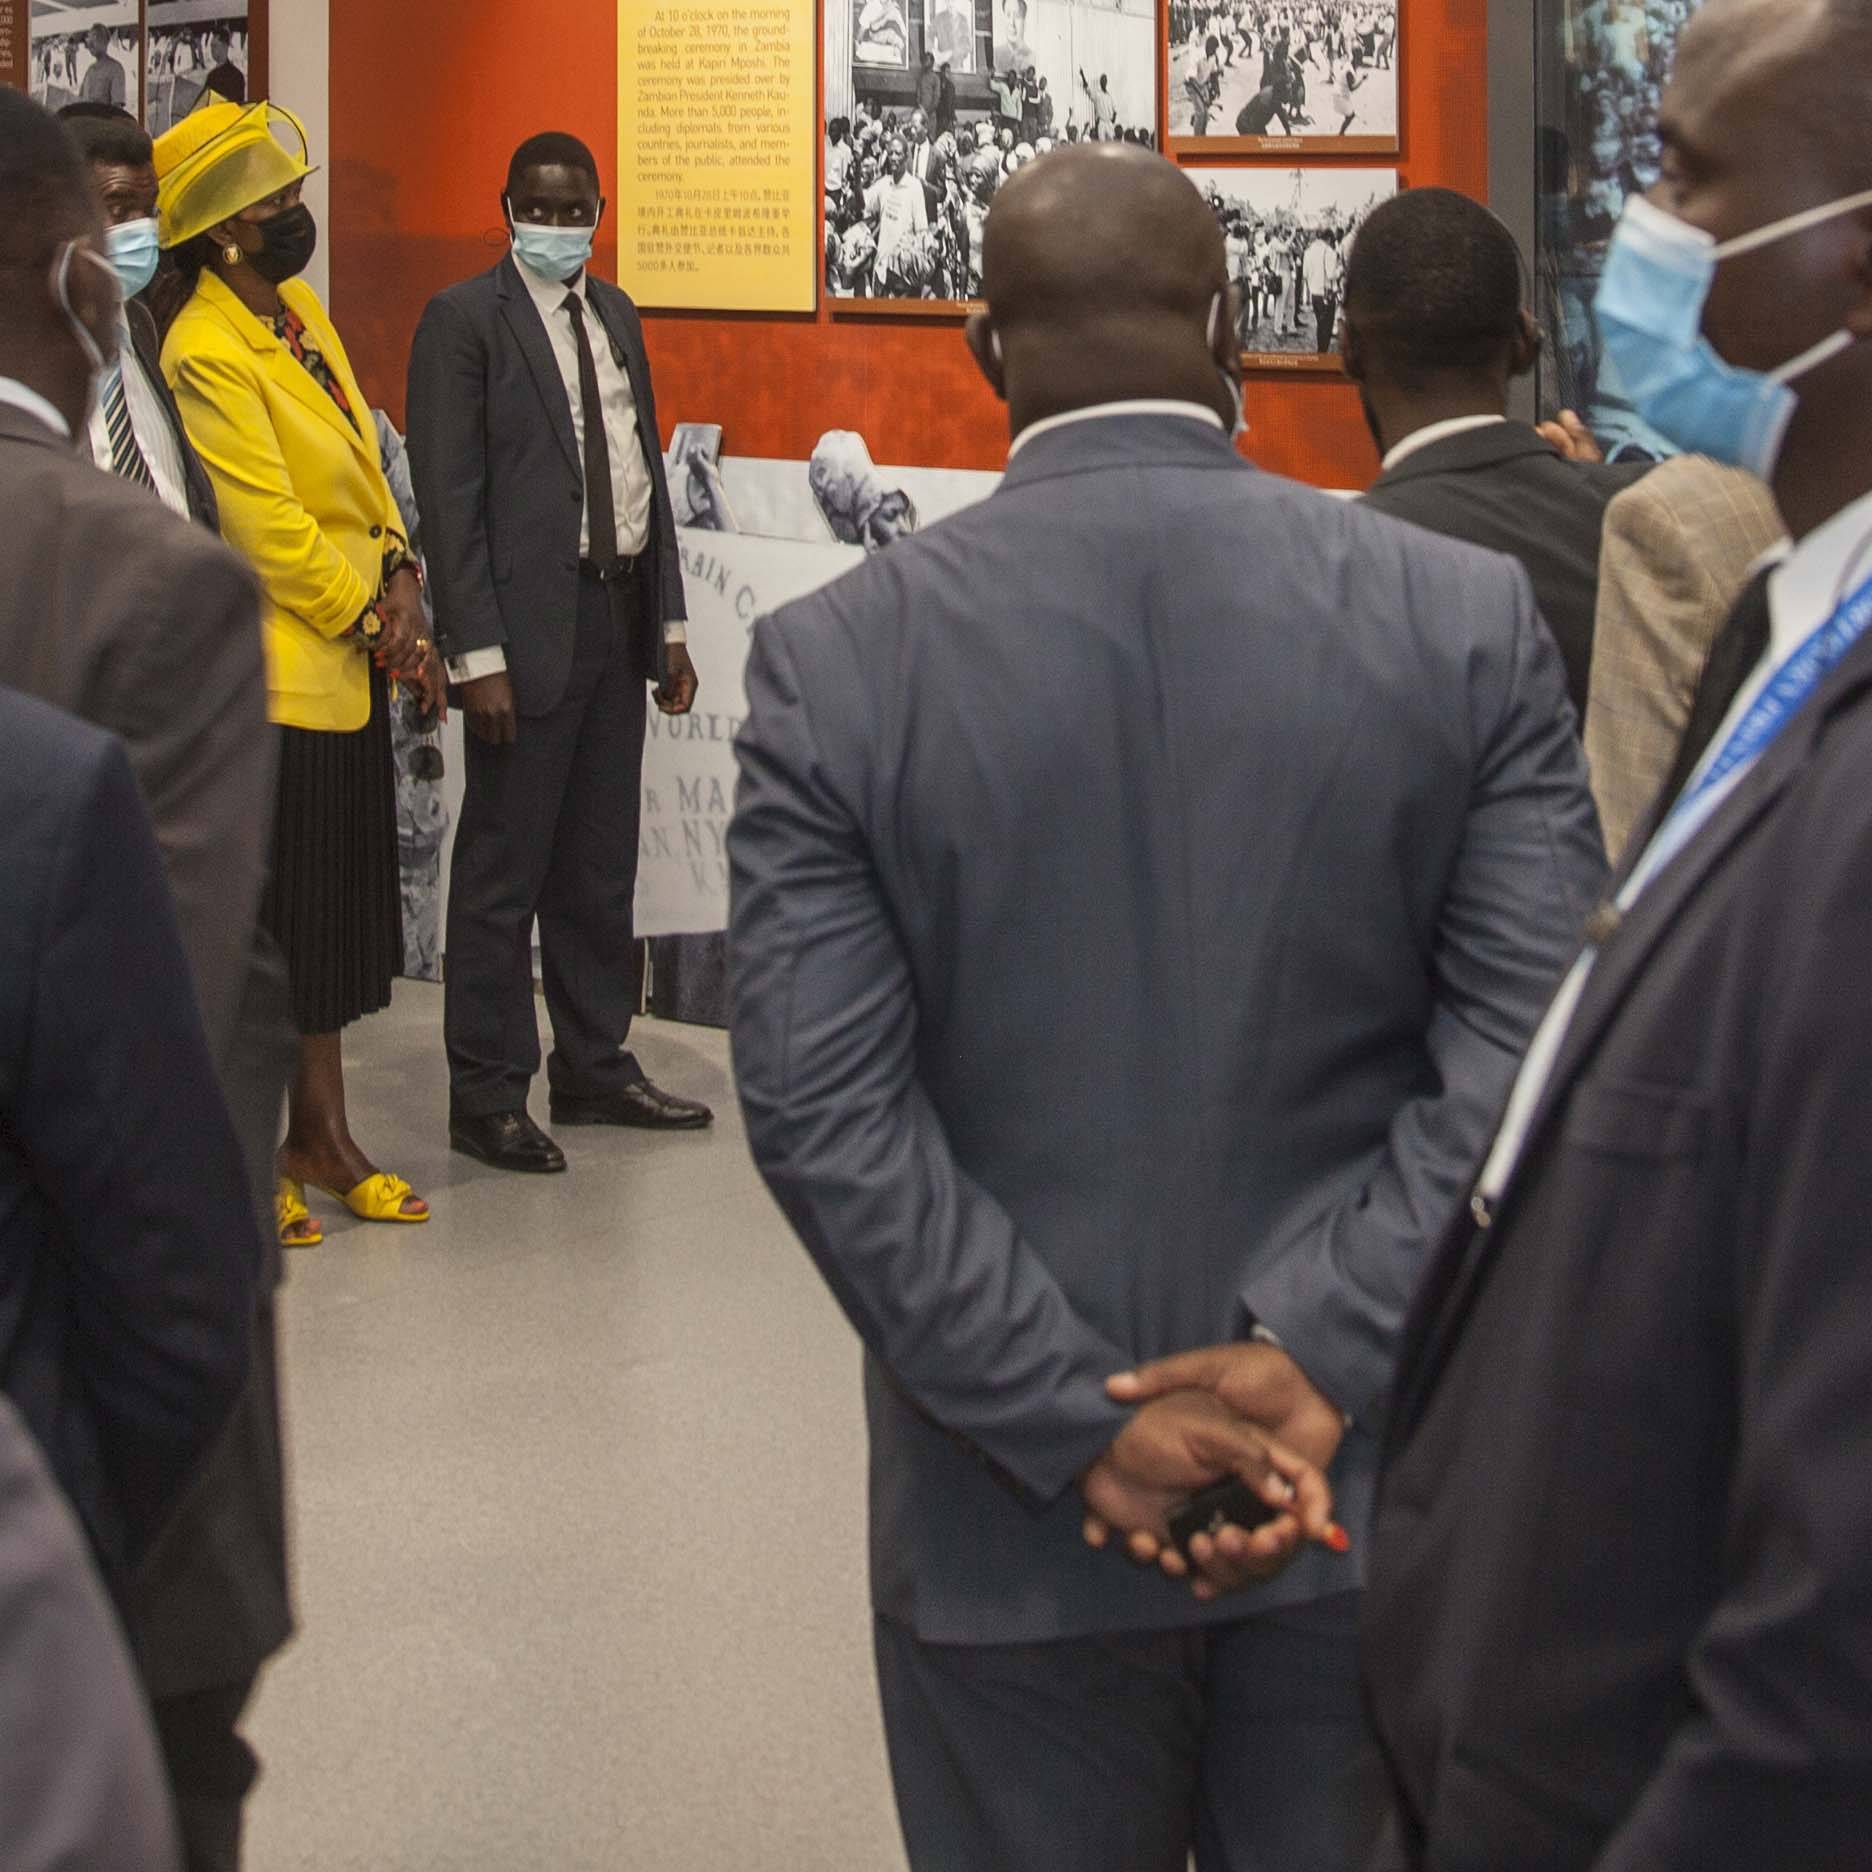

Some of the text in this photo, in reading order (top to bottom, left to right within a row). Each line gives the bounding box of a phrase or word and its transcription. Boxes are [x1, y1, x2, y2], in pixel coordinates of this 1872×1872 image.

[655, 10, 665, 21] At
[669, 10, 678, 21] 10
[717, 11, 728, 19] on
[731, 8, 745, 19] the
[750, 8, 790, 21] morning
[638, 27, 647, 38] of
[650, 26, 685, 38] October
[734, 25, 749, 36] the
[638, 41, 790, 55] breaking ceremony in Zambia
[637, 61, 656, 70] was
[660, 59, 680, 70] held
[774, 56, 790, 67] The
[637, 73, 790, 88] ceremony was presided over by
[638, 90, 679, 102] Zambian
[680, 90, 723, 102] President
[726, 90, 765, 101] Kenneth
[661, 106, 684, 117] More
[687, 106, 708, 116] than
[637, 122, 790, 136] cluding diplomats from various
[739, 139, 757, 150] and
[638, 155, 658, 166] bers
[662, 155, 671, 166] of
[675, 155, 690, 166] the
[729, 155, 771, 166] attended
[775, 154, 790, 166] the
